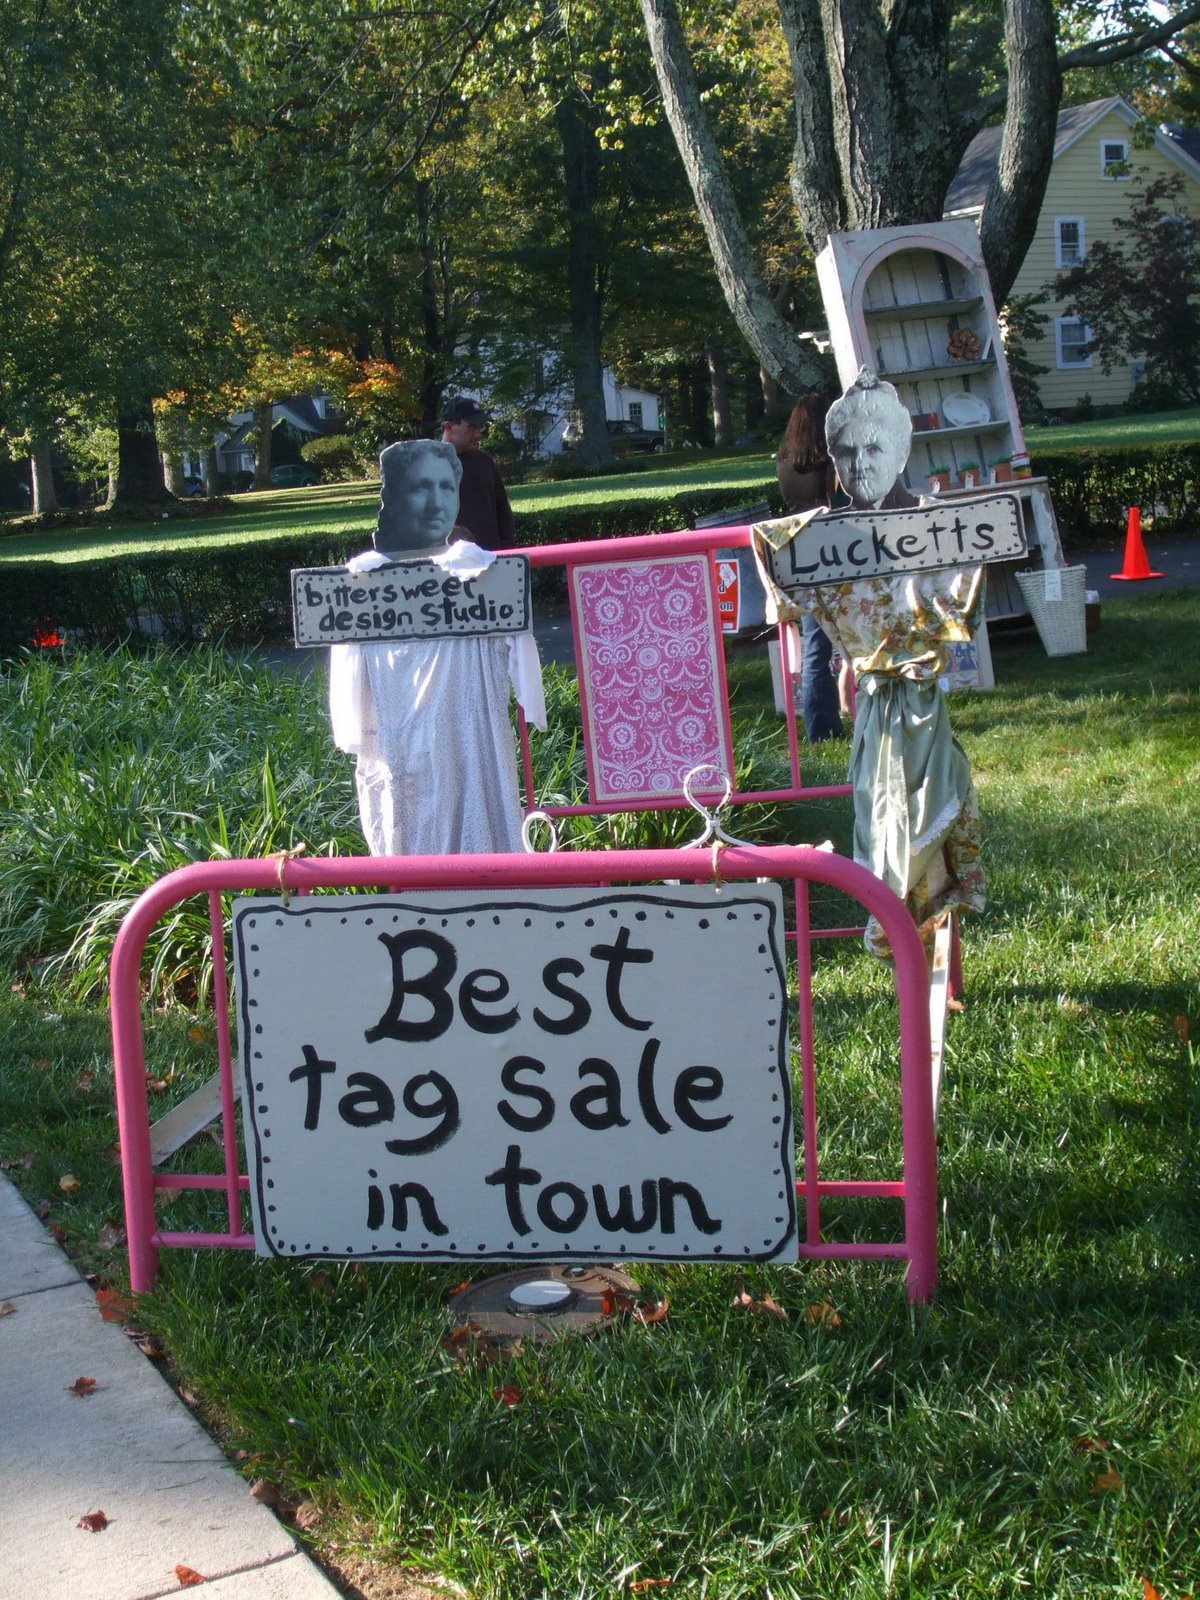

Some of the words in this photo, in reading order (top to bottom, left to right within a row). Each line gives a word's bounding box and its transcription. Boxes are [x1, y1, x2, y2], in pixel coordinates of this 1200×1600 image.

[790, 516, 994, 575] Lucketts
[319, 606, 413, 632] design
[364, 926, 654, 1043] Best
[289, 1044, 461, 1155] tag
[497, 1038, 734, 1135] sale
[366, 1169, 449, 1236] in
[485, 1144, 722, 1236] town
